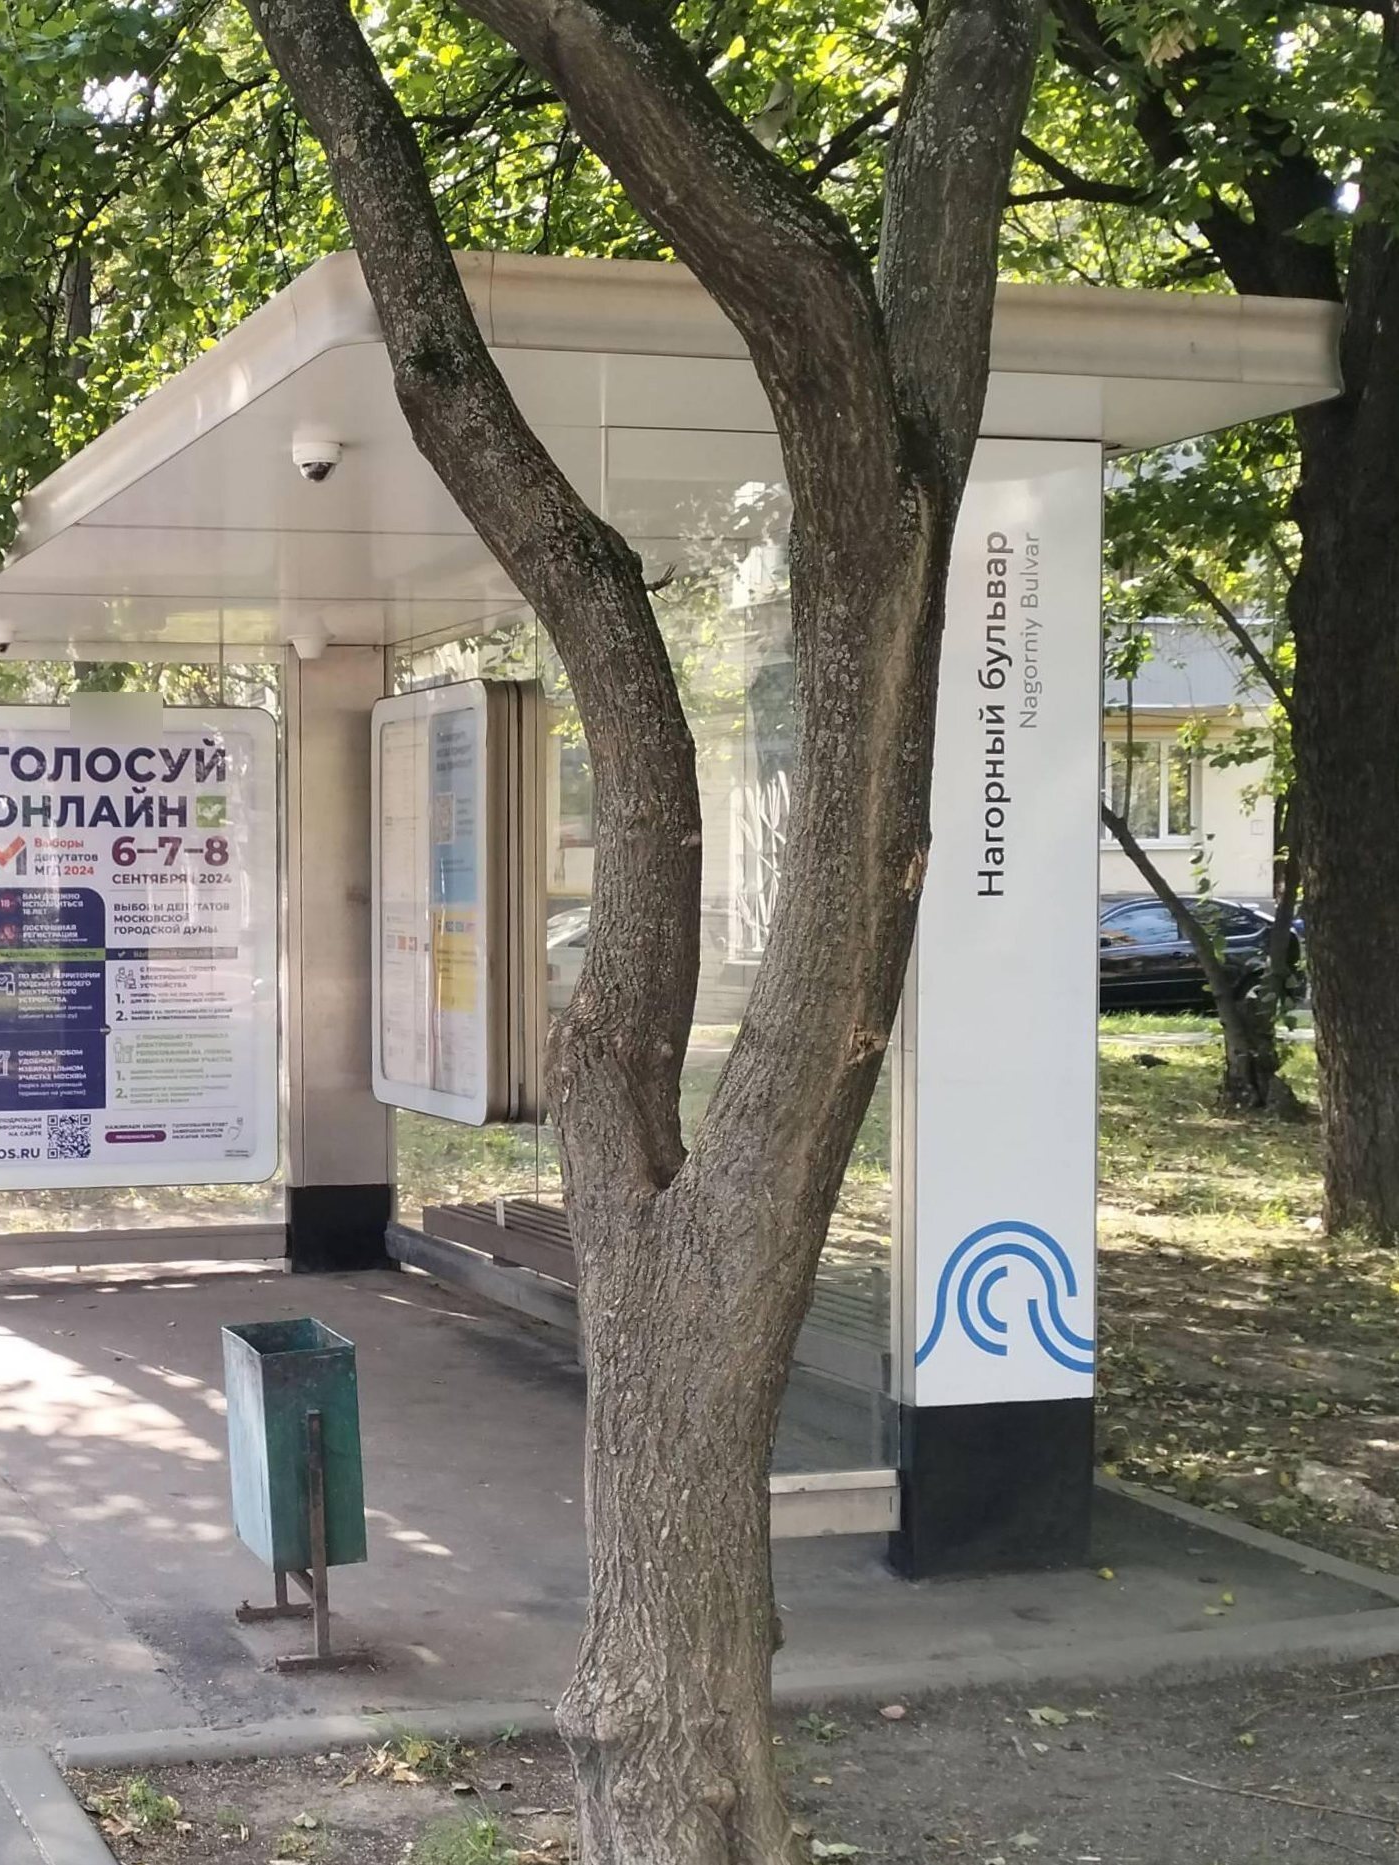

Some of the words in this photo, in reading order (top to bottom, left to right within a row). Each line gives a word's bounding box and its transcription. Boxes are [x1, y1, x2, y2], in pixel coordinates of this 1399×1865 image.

[1019, 532, 1039, 608] Bulvar
[977, 531, 1014, 690] бульвар
[1019, 618, 1043, 728] Nagorniy
[977, 704, 1012, 897] Нагорный
[64, 865, 95, 876] 2024
[112, 873, 187, 885] СЕНТЯБРЯ
[199, 873, 232, 884] 2024
[167, 902, 230, 912] ДЕПТАТОВ
[114, 924, 180, 935] ГОРОДСКОЙ
[183, 925, 218, 936] ДУМЫ
